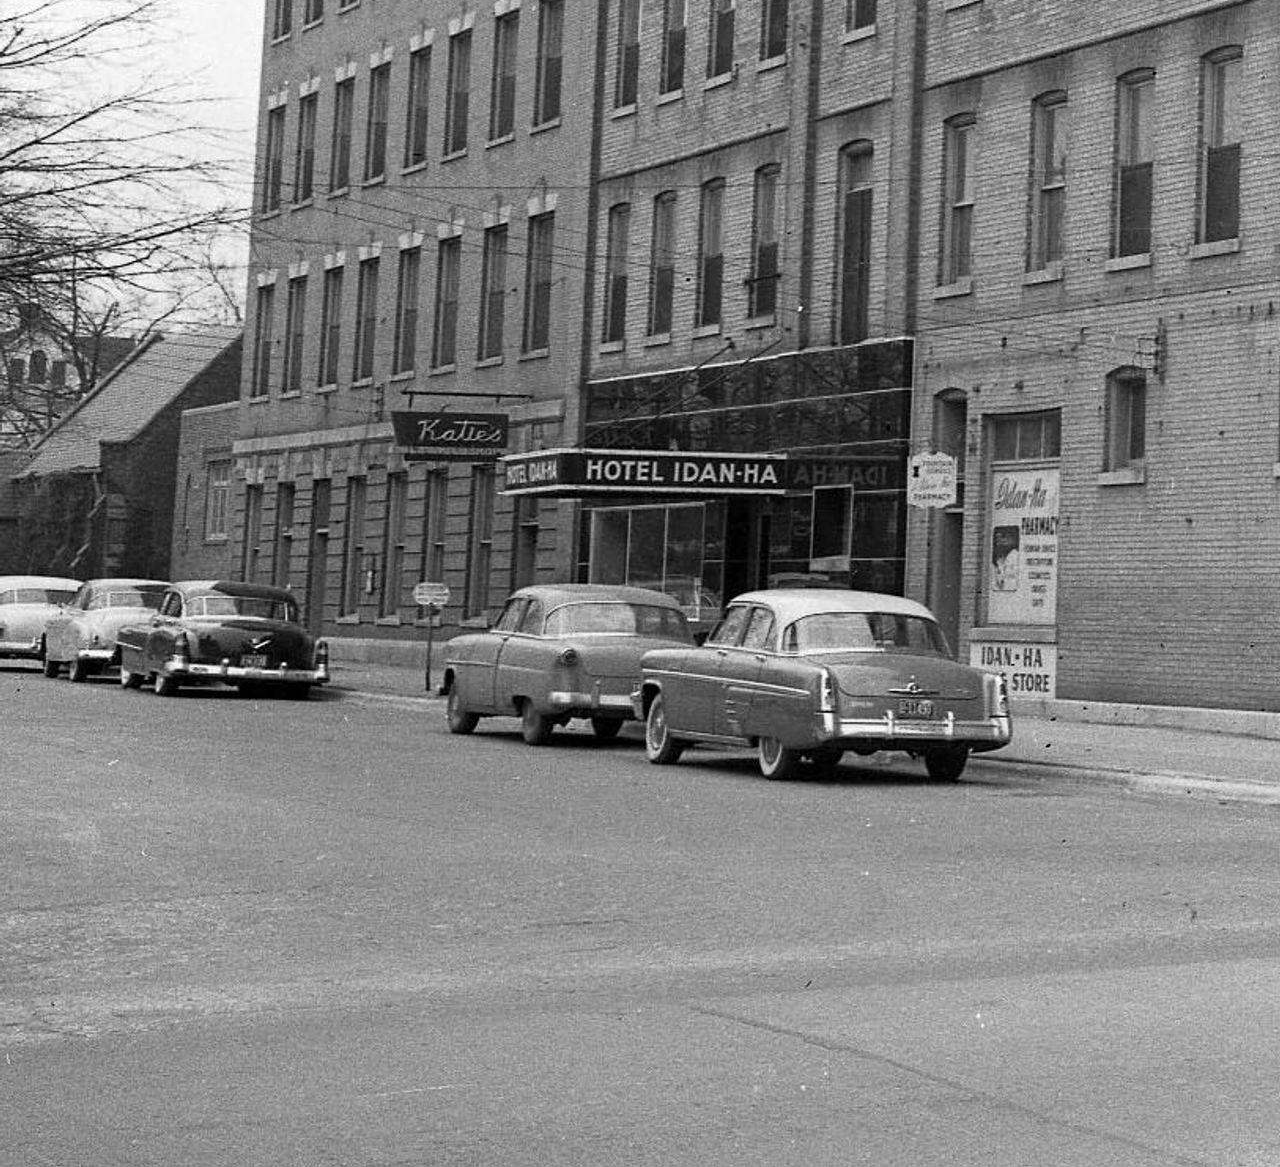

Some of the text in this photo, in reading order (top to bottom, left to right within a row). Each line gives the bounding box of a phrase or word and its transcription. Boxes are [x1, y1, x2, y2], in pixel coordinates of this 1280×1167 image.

[586, 459, 778, 484] HOTEL IDAN-HA
[1012, 672, 1050, 693] STORE
